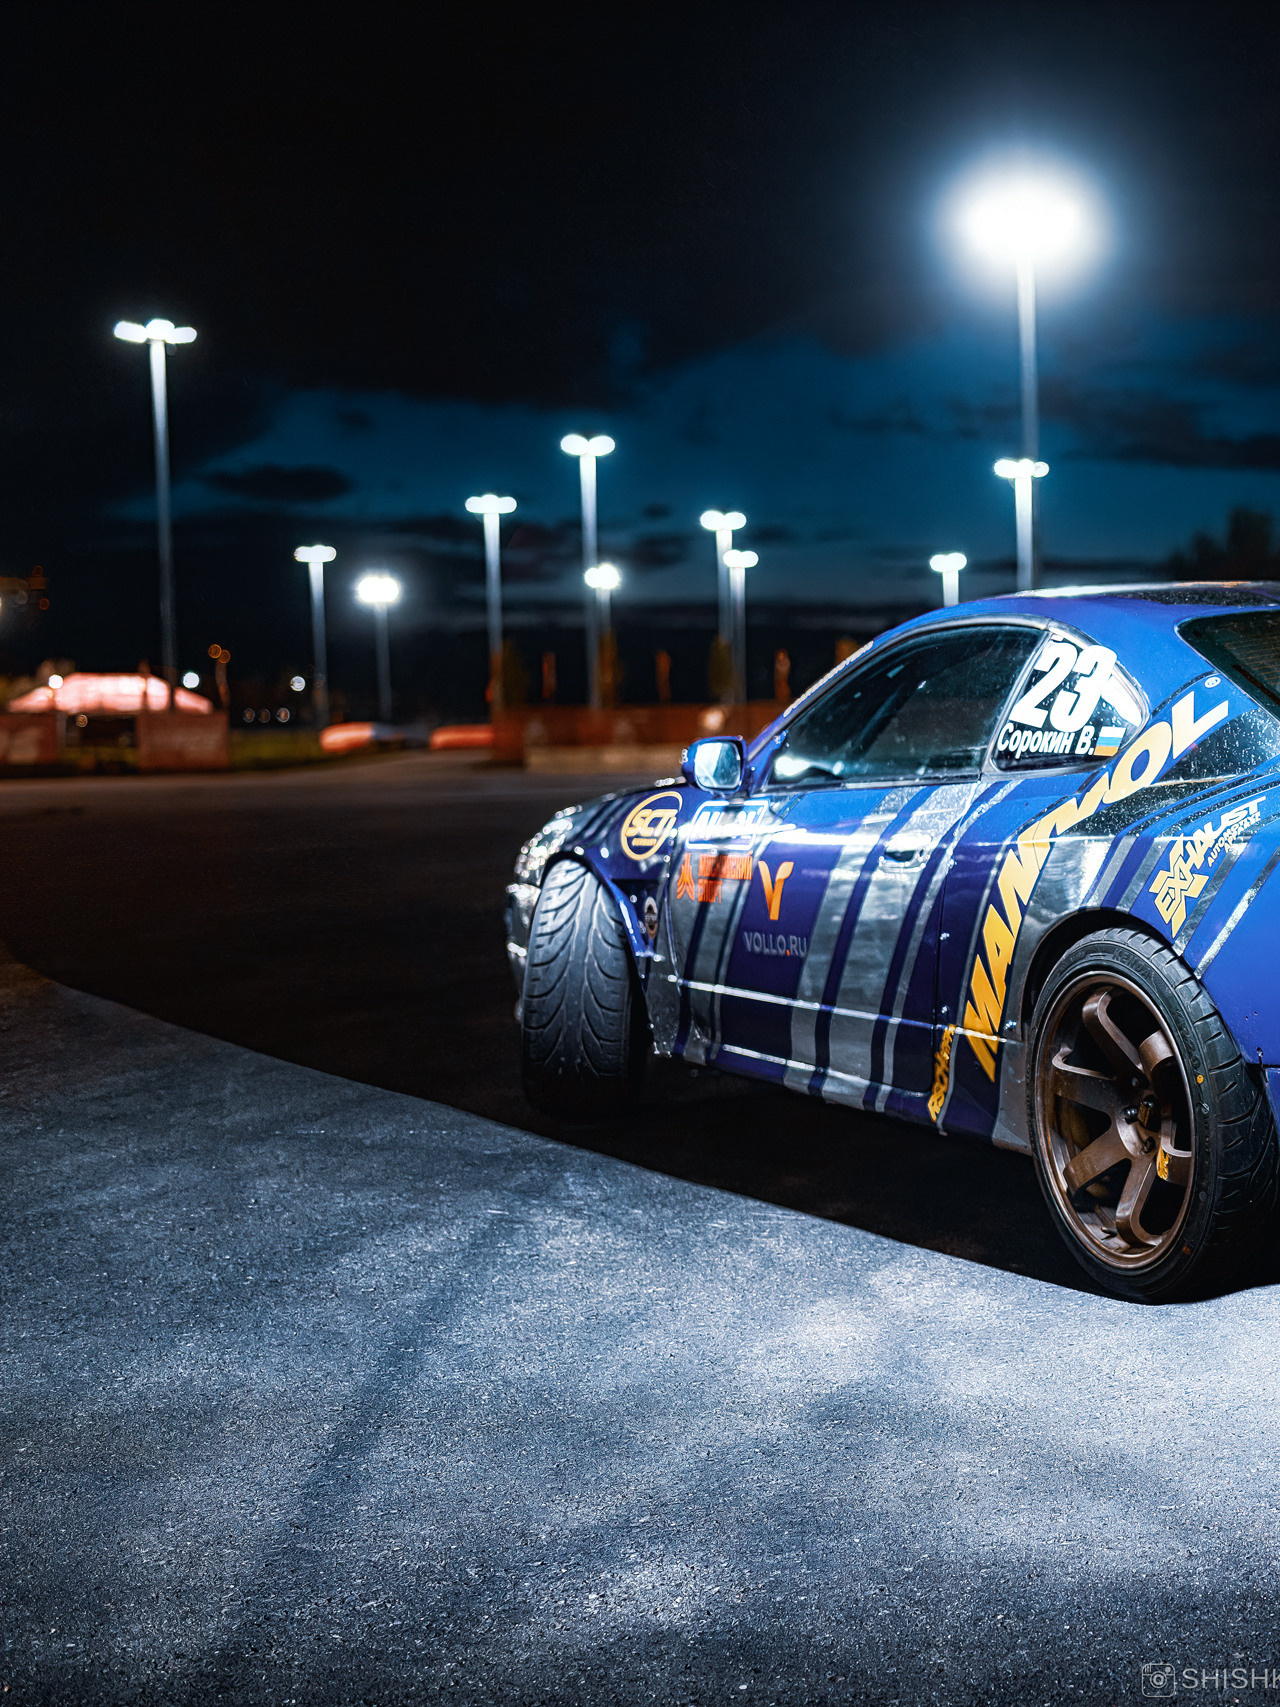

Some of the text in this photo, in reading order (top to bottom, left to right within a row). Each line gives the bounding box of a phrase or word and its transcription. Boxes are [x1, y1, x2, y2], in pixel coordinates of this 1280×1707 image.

[1008, 641, 1118, 733] 23
[997, 722, 1075, 759] Сорокин
[963, 691, 1229, 1083] MANNOL
[743, 930, 808, 957] VOLLO.RU
